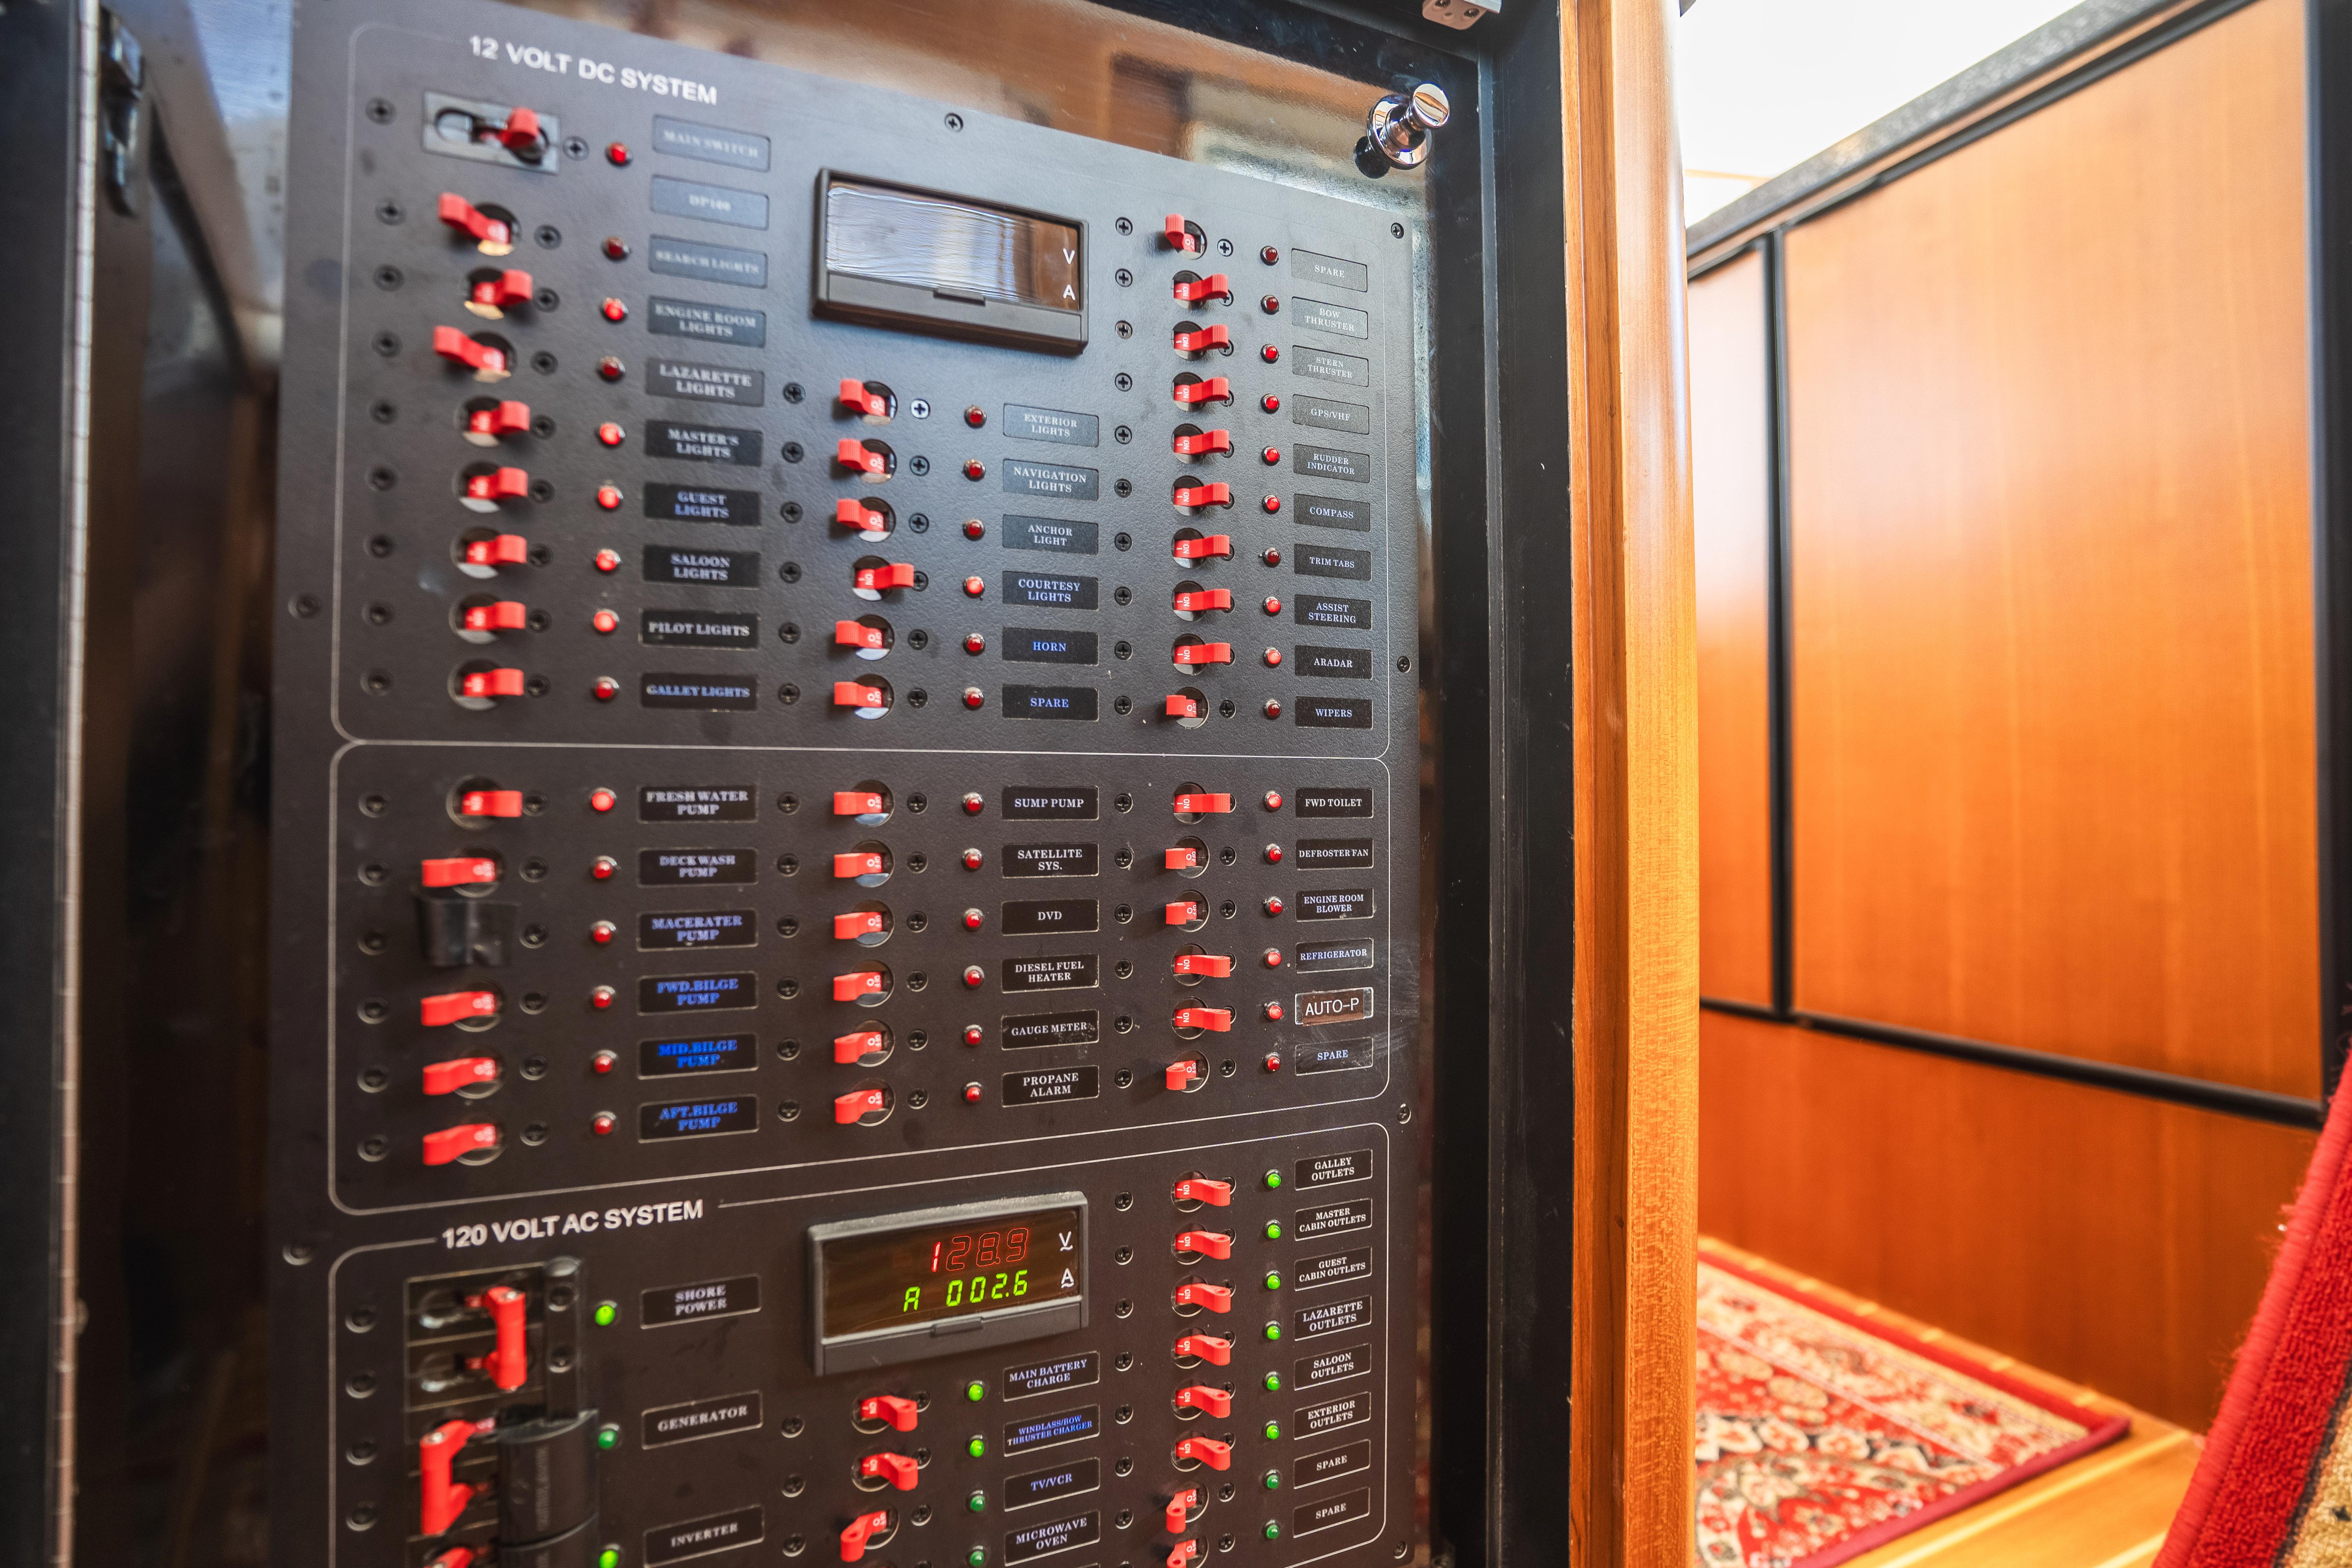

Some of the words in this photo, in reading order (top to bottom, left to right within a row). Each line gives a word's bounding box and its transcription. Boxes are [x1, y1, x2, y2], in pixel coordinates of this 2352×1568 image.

[470, 35, 498, 60] 12
[506, 42, 572, 74] VOLT
[578, 57, 615, 84] DC
[621, 67, 717, 105] SYSTEM
[663, 130, 700, 146] MAIN
[704, 138, 759, 158] SWITCH
[655, 250, 710, 268] SEARCH
[711, 258, 760, 274] LIGHTS
[1062, 248, 1075, 265] V
[1315, 265, 1345, 278] SPARE
[1062, 284, 1076, 301] A
[655, 304, 711, 321] ENGINE
[715, 310, 756, 327] ROOM
[1319, 308, 1340, 319] BOW
[679, 321, 733, 337] LIGHTS
[1305, 316, 1354, 331] THRUSTER
[1316, 357, 1344, 368] STERN
[659, 363, 752, 387] LAZARETTE
[1307, 365, 1352, 378] THRUSTER
[676, 380, 735, 399] LIGHTS
[1024, 413, 1077, 428] EXTERIOR
[1311, 408, 1350, 421] GPS/VHF
[668, 428, 739, 446] MASTER'S
[1031, 425, 1070, 437] LIGHTS
[676, 443, 731, 458] LIGHTS
[1314, 454, 1349, 465] RUDDER
[1014, 467, 1087, 483] NAVIGATION
[1307, 462, 1355, 475] INDICATOR
[1029, 480, 1072, 493] LIGHTS
[677, 491, 727, 505] GUEST
[674, 504, 729, 518] LIGHTS
[1309, 507, 1354, 519] COMPASS
[1028, 525, 1073, 536] ANCHOR
[1034, 535, 1067, 546] LIGHT
[670, 554, 730, 568] SALOON
[1310, 557, 1332, 566] TRIM
[1333, 559, 1354, 568] TABS
[673, 567, 728, 581] LIGHTS
[1019, 579, 1080, 592] COURTESY
[1028, 591, 1071, 602] LIGHTS
[1316, 603, 1349, 612] ASSIST
[1308, 612, 1356, 624] STEERING
[648, 621, 693, 634] PILOT
[696, 623, 750, 637] LIGHTS
[1033, 642, 1066, 652] HORN
[1314, 658, 1353, 668] ARADAR
[646, 684, 699, 696] GALLEY
[701, 686, 750, 698] LIGHTS
[1030, 698, 1069, 708] SPARE
[1315, 708, 1352, 718] WIPERS
[646, 791, 695, 803] FRESH
[697, 791, 748, 802] WATER
[1014, 799, 1048, 808] SUMP
[1051, 799, 1084, 808] PUMP
[1328, 799, 1362, 807] TOILET
[677, 804, 720, 815] PUMP
[659, 855, 697, 866] DECK
[698, 855, 736, 866] WASH
[1018, 849, 1082, 859] SATELLITE
[1299, 849, 1350, 858] DEFROSTER
[679, 867, 718, 878] PUMP
[1038, 862, 1062, 871] SYS.
[1304, 895, 1337, 904] ENGINE
[1339, 894, 1364, 902] ROOM
[1038, 911, 1062, 920] DVD
[1316, 904, 1352, 913] BLOWER
[652, 915, 743, 930] MACERATER
[677, 929, 720, 942] PUMP
[1300, 949, 1367, 961] REFRIGERATOR
[1015, 963, 1054, 973] DIESEL
[1057, 961, 1084, 970] FUEL
[1029, 972, 1071, 982] HEATER
[677, 992, 720, 1006] PUMP
[1305, 998, 1359, 1016] AUTO-P
[1011, 1025, 1049, 1036] GAUGE
[1051, 1022, 1087, 1033] METER
[677, 1054, 720, 1068] PUMP
[1317, 1049, 1348, 1061] SPARE
[1023, 1073, 1078, 1086] PROPANE
[1030, 1085, 1071, 1097] ALARM
[678, 1116, 721, 1131] PUMP
[1315, 1157, 1352, 1170] GALLEY
[1312, 1167, 1354, 1181] OUTLETS
[1316, 1208, 1350, 1220] MASTER
[442, 1224, 488, 1249] 120
[491, 1215, 561, 1243] VOLT
[561, 1210, 599, 1235] AC
[604, 1199, 704, 1230] SYSTEM
[1299, 1221, 1326, 1232] CABIN
[1328, 1214, 1366, 1227] OUTLETS
[1318, 1257, 1347, 1269] GUEST
[1299, 1270, 1325, 1282] CABIN
[1328, 1262, 1366, 1276] OUTLETS
[675, 1284, 726, 1303] SHORE
[903, 1286, 920, 1312] A
[946, 1270, 1028, 1307] 002.6
[674, 1297, 728, 1316] POWER
[1303, 1301, 1363, 1322] LAZARETTE
[1309, 1313, 1357, 1332] OUTLETS
[1314, 1353, 1352, 1369] SALOON
[1009, 1369, 1037, 1382] MAIN
[1039, 1359, 1087, 1376] BATTERY
[1311, 1362, 1354, 1379] OUTLETS
[1027, 1373, 1071, 1389] CHARGE
[1308, 1400, 1355, 1420] EXTERIOR
[657, 1405, 749, 1433] GENERATOR
[1018, 1415, 1082, 1435] WINDLASS/BOW
[1310, 1411, 1353, 1429] OUTLETS
[1007, 1430, 1052, 1446] THRUSTER
[1053, 1421, 1092, 1436] CHARGER
[1316, 1455, 1347, 1471] SPARE
[1031, 1474, 1073, 1491] TV/VCR
[1316, 1503, 1346, 1519] SPARE
[670, 1522, 739, 1548] INVERTER
[1016, 1517, 1087, 1544] MICROWAVE
[1036, 1534, 1067, 1550] OVEN
